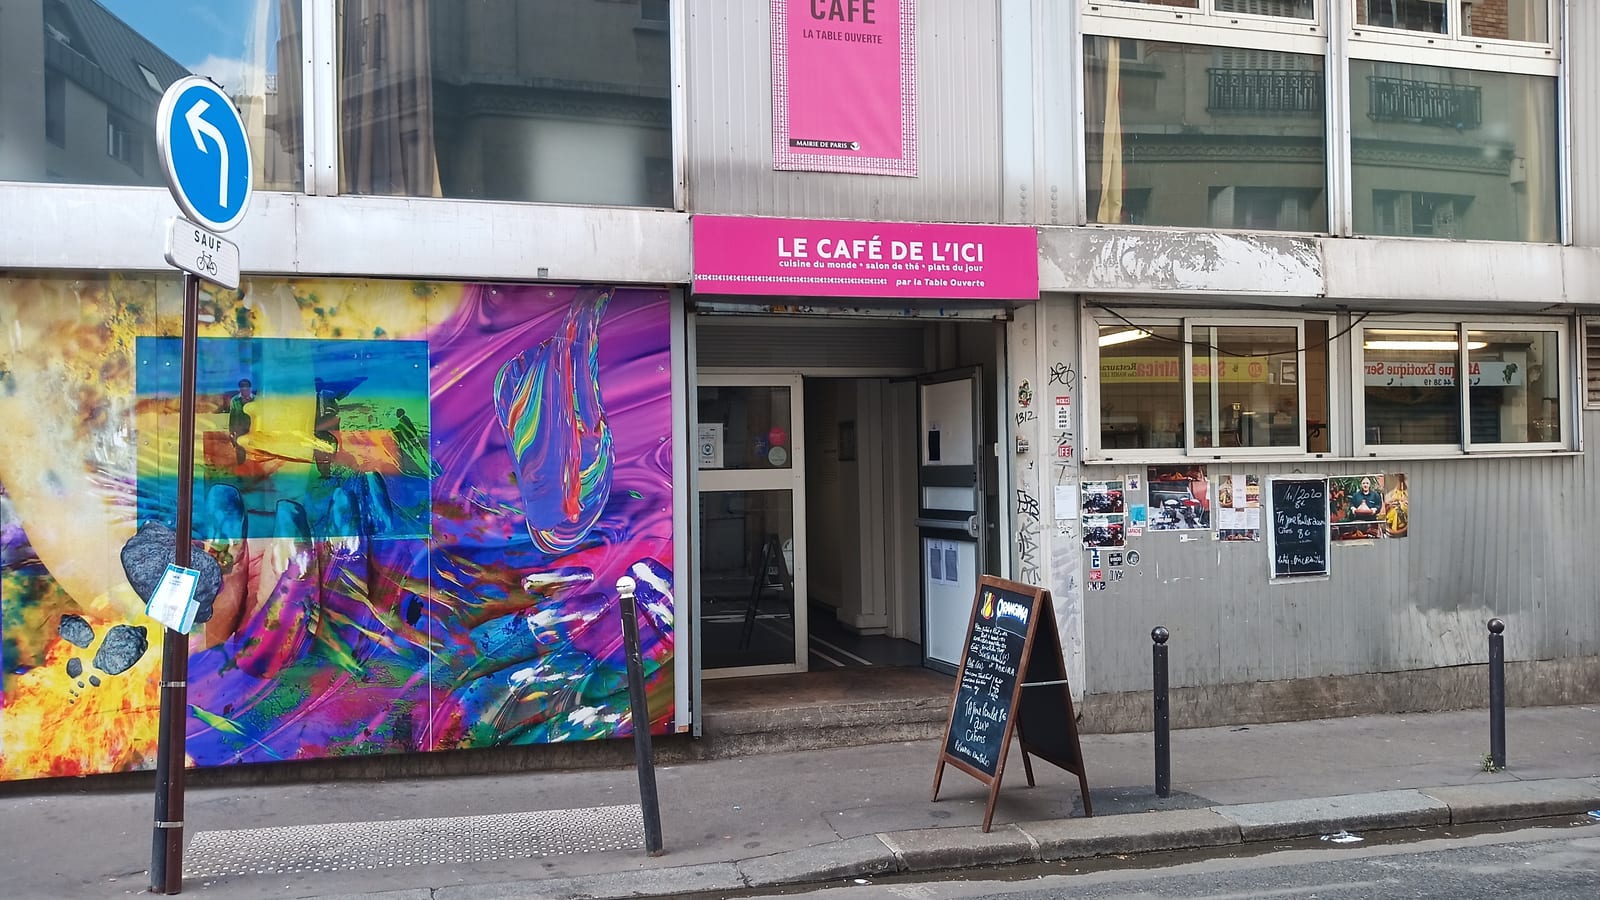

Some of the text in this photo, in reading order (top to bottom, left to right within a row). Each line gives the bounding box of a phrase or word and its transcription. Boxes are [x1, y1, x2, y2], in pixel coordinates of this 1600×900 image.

[803, 29, 883, 44] LA TABLE OUVERTE
[194, 230, 221, 252] SAUF
[778, 235, 983, 262] LE CAFÉ DE L'ICI
[779, 260, 811, 268] cuisine
[813, 260, 825, 268] du
[827, 261, 857, 269] monde
[865, 262, 889, 270] salon
[892, 262, 903, 270] de
[928, 264, 950, 272] plats
[965, 264, 983, 272] jour
[896, 279, 912, 287] par
[914, 278, 922, 286] la
[950, 279, 985, 287] Ouverte
